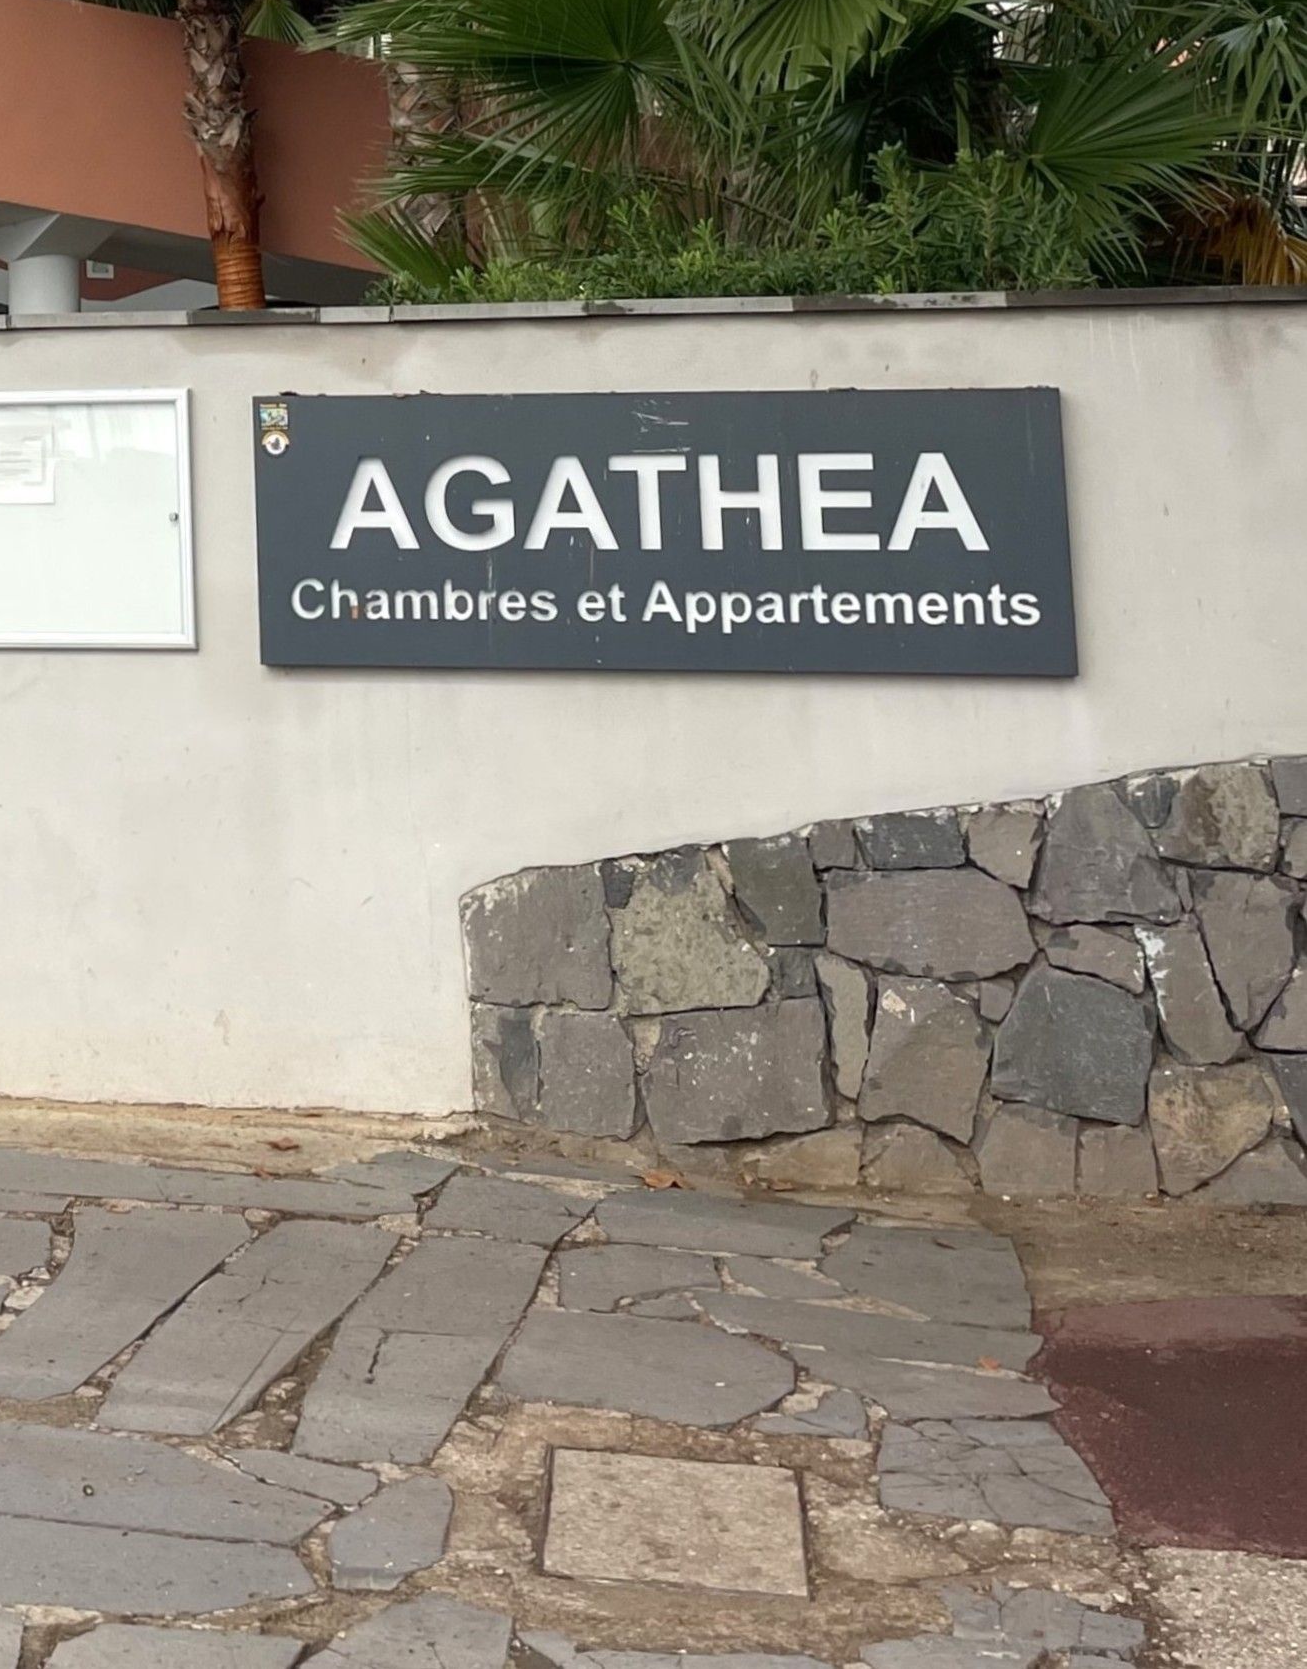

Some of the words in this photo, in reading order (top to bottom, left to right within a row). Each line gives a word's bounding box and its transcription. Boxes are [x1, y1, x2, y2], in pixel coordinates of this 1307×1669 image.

[328, 452, 992, 553] AGATHEA
[290, 577, 559, 623] Chambres
[576, 583, 629, 624] et
[641, 580, 1042, 635] Appartements
